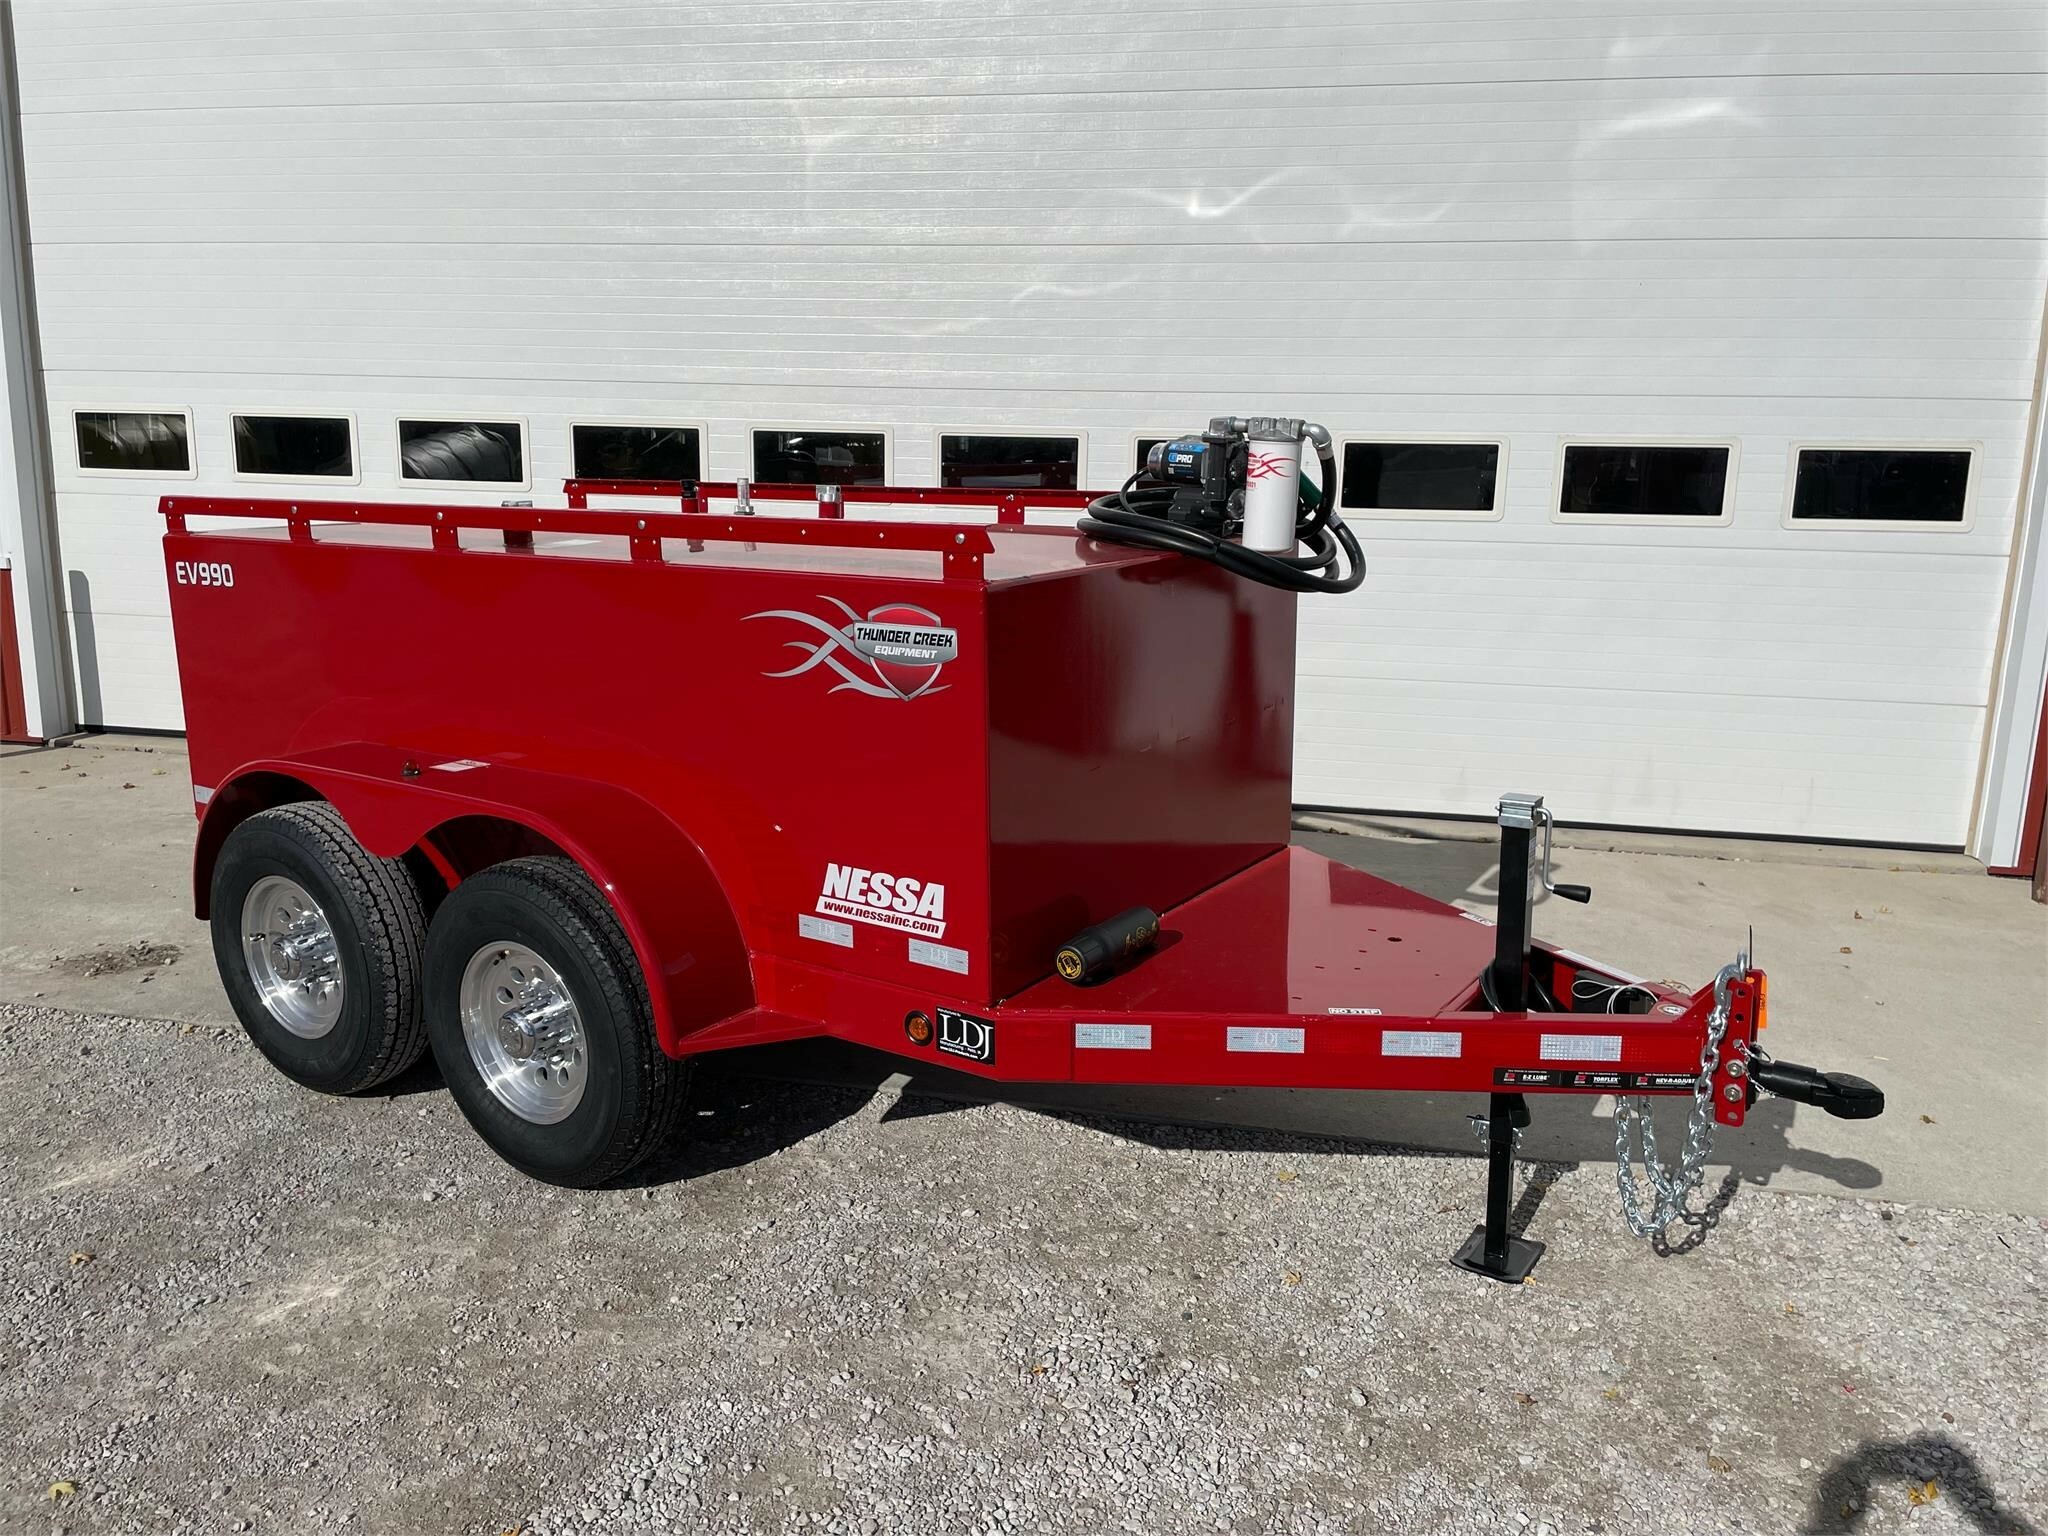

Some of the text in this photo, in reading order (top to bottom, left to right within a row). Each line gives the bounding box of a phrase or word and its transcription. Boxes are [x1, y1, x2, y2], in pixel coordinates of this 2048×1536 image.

[175, 561, 234, 588] EV990
[857, 627, 954, 648] THUNDER CREEK
[874, 645, 938, 659] EQUIPMENT
[822, 862, 945, 921] NESSA
[823, 900, 940, 934] www.nessainc.com
[940, 1013, 994, 1060] LDJ
